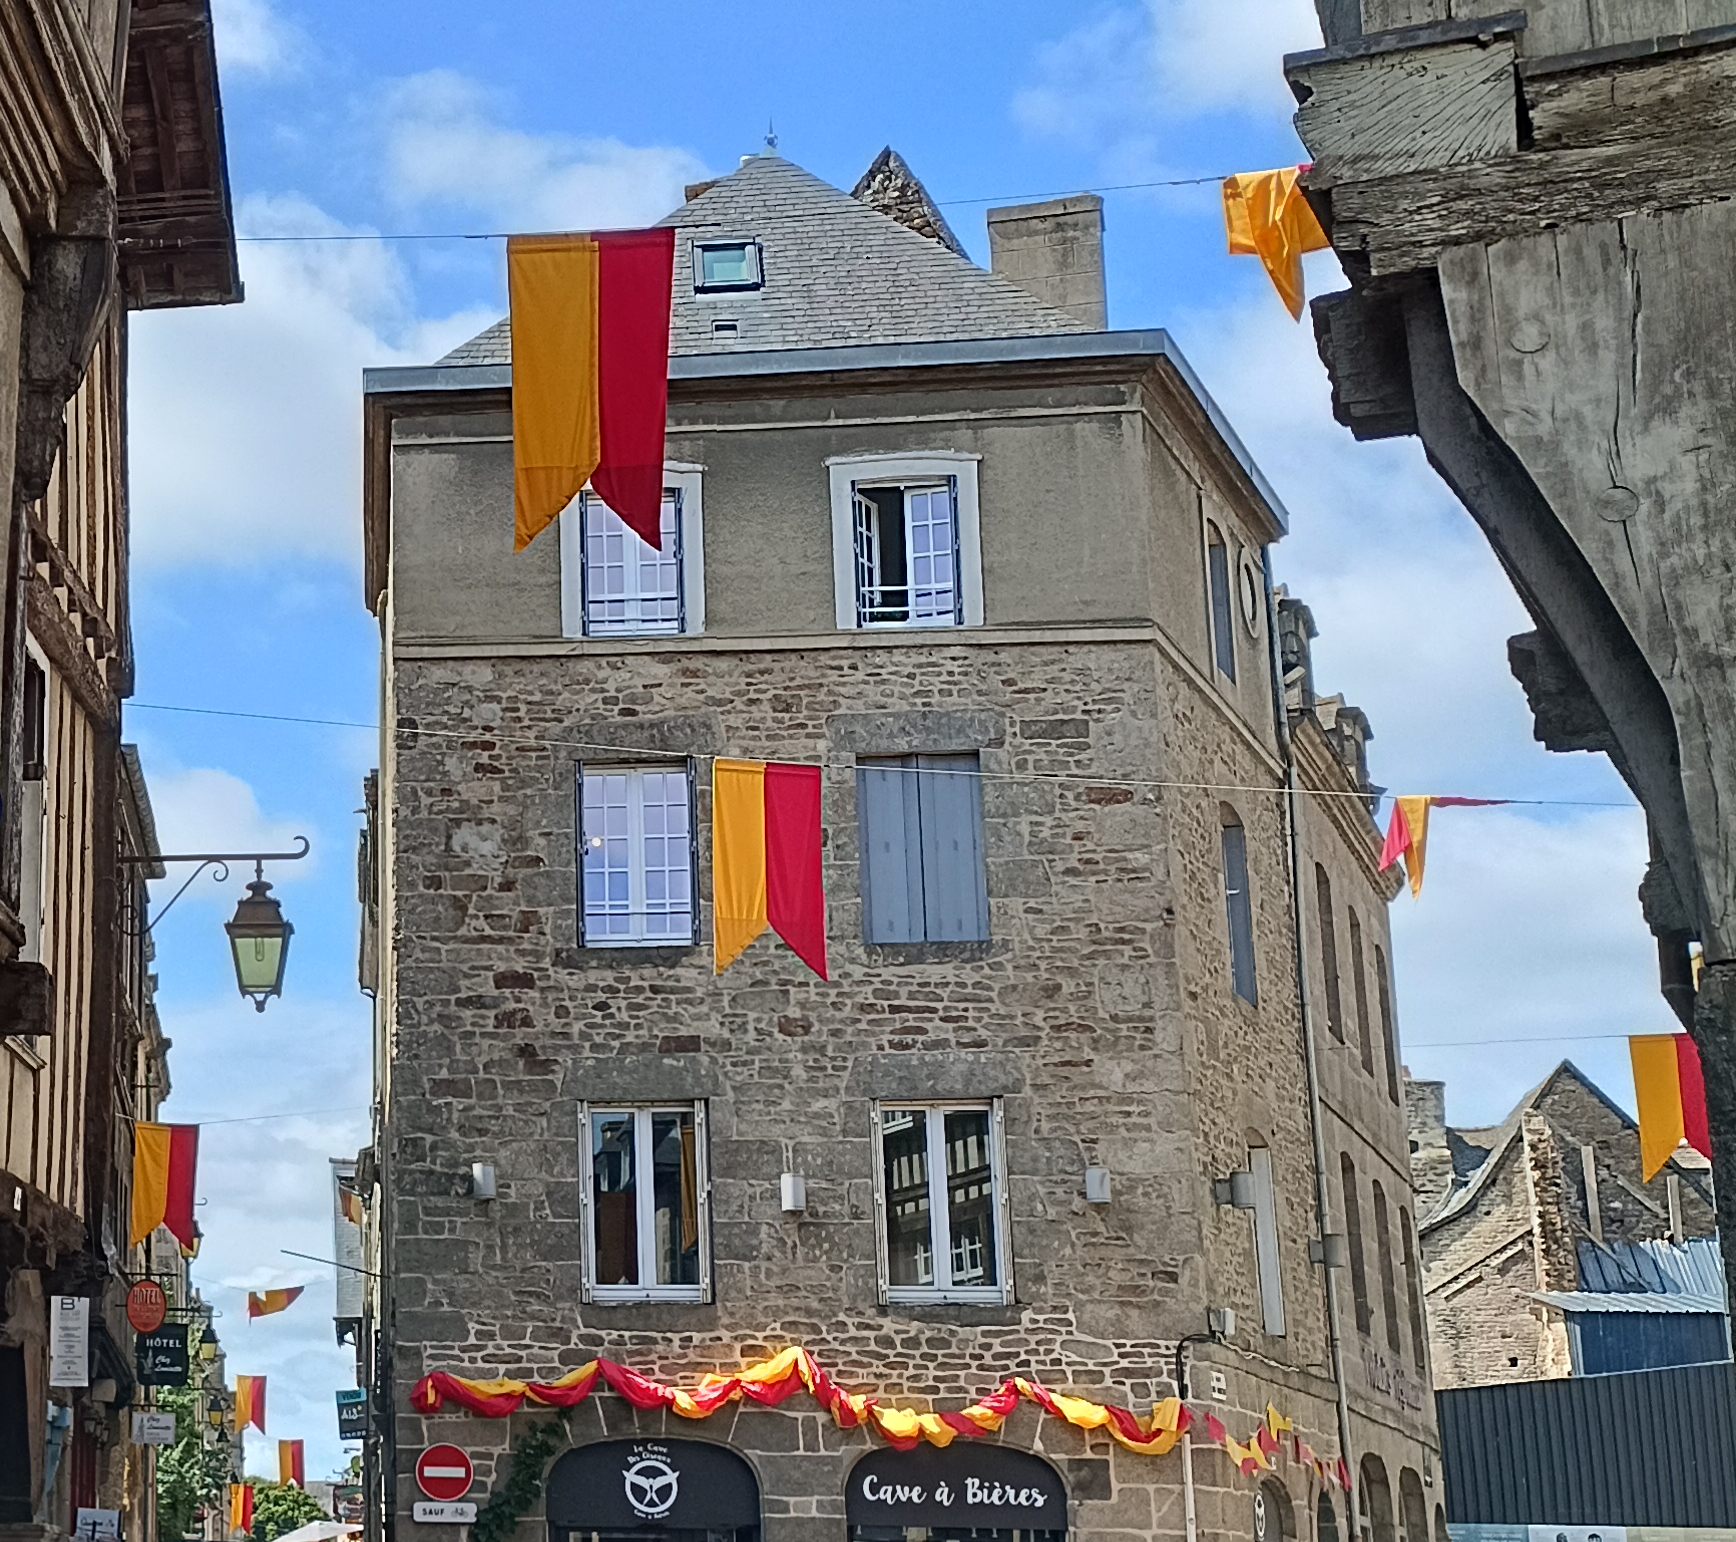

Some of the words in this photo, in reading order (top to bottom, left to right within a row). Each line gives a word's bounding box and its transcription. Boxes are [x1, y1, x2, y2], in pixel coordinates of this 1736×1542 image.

[146, 1337, 182, 1348] HÔTEL
[862, 1474, 928, 1506] Cave
[934, 1481, 955, 1506] à
[965, 1476, 1049, 1508] Bières
[422, 1507, 446, 1516] SAUF
